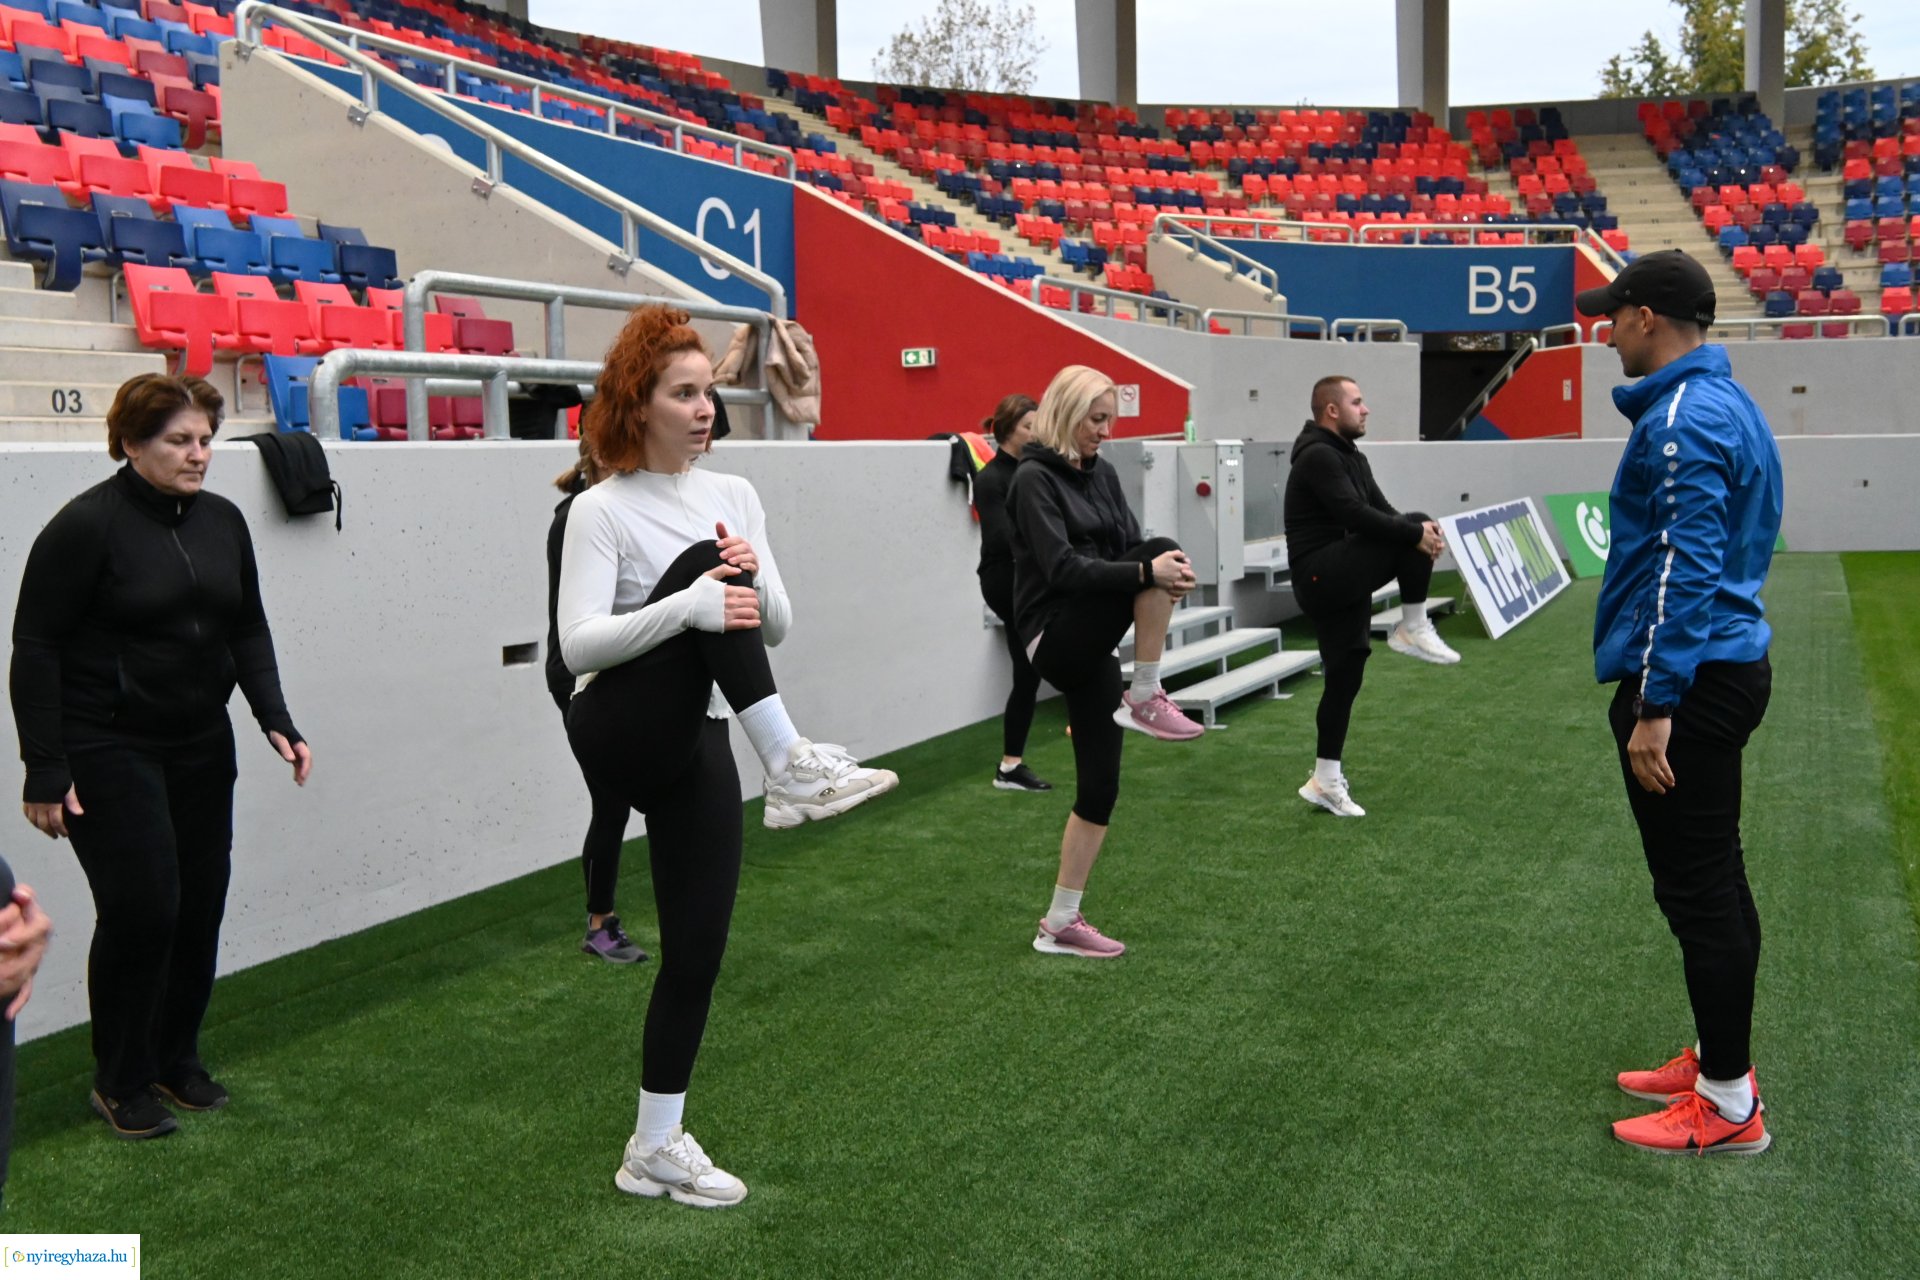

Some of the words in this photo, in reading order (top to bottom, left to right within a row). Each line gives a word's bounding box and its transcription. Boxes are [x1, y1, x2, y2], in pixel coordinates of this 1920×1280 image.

[695, 196, 762, 280] C1
[1469, 265, 1537, 314] B5
[52, 389, 82, 414] 03
